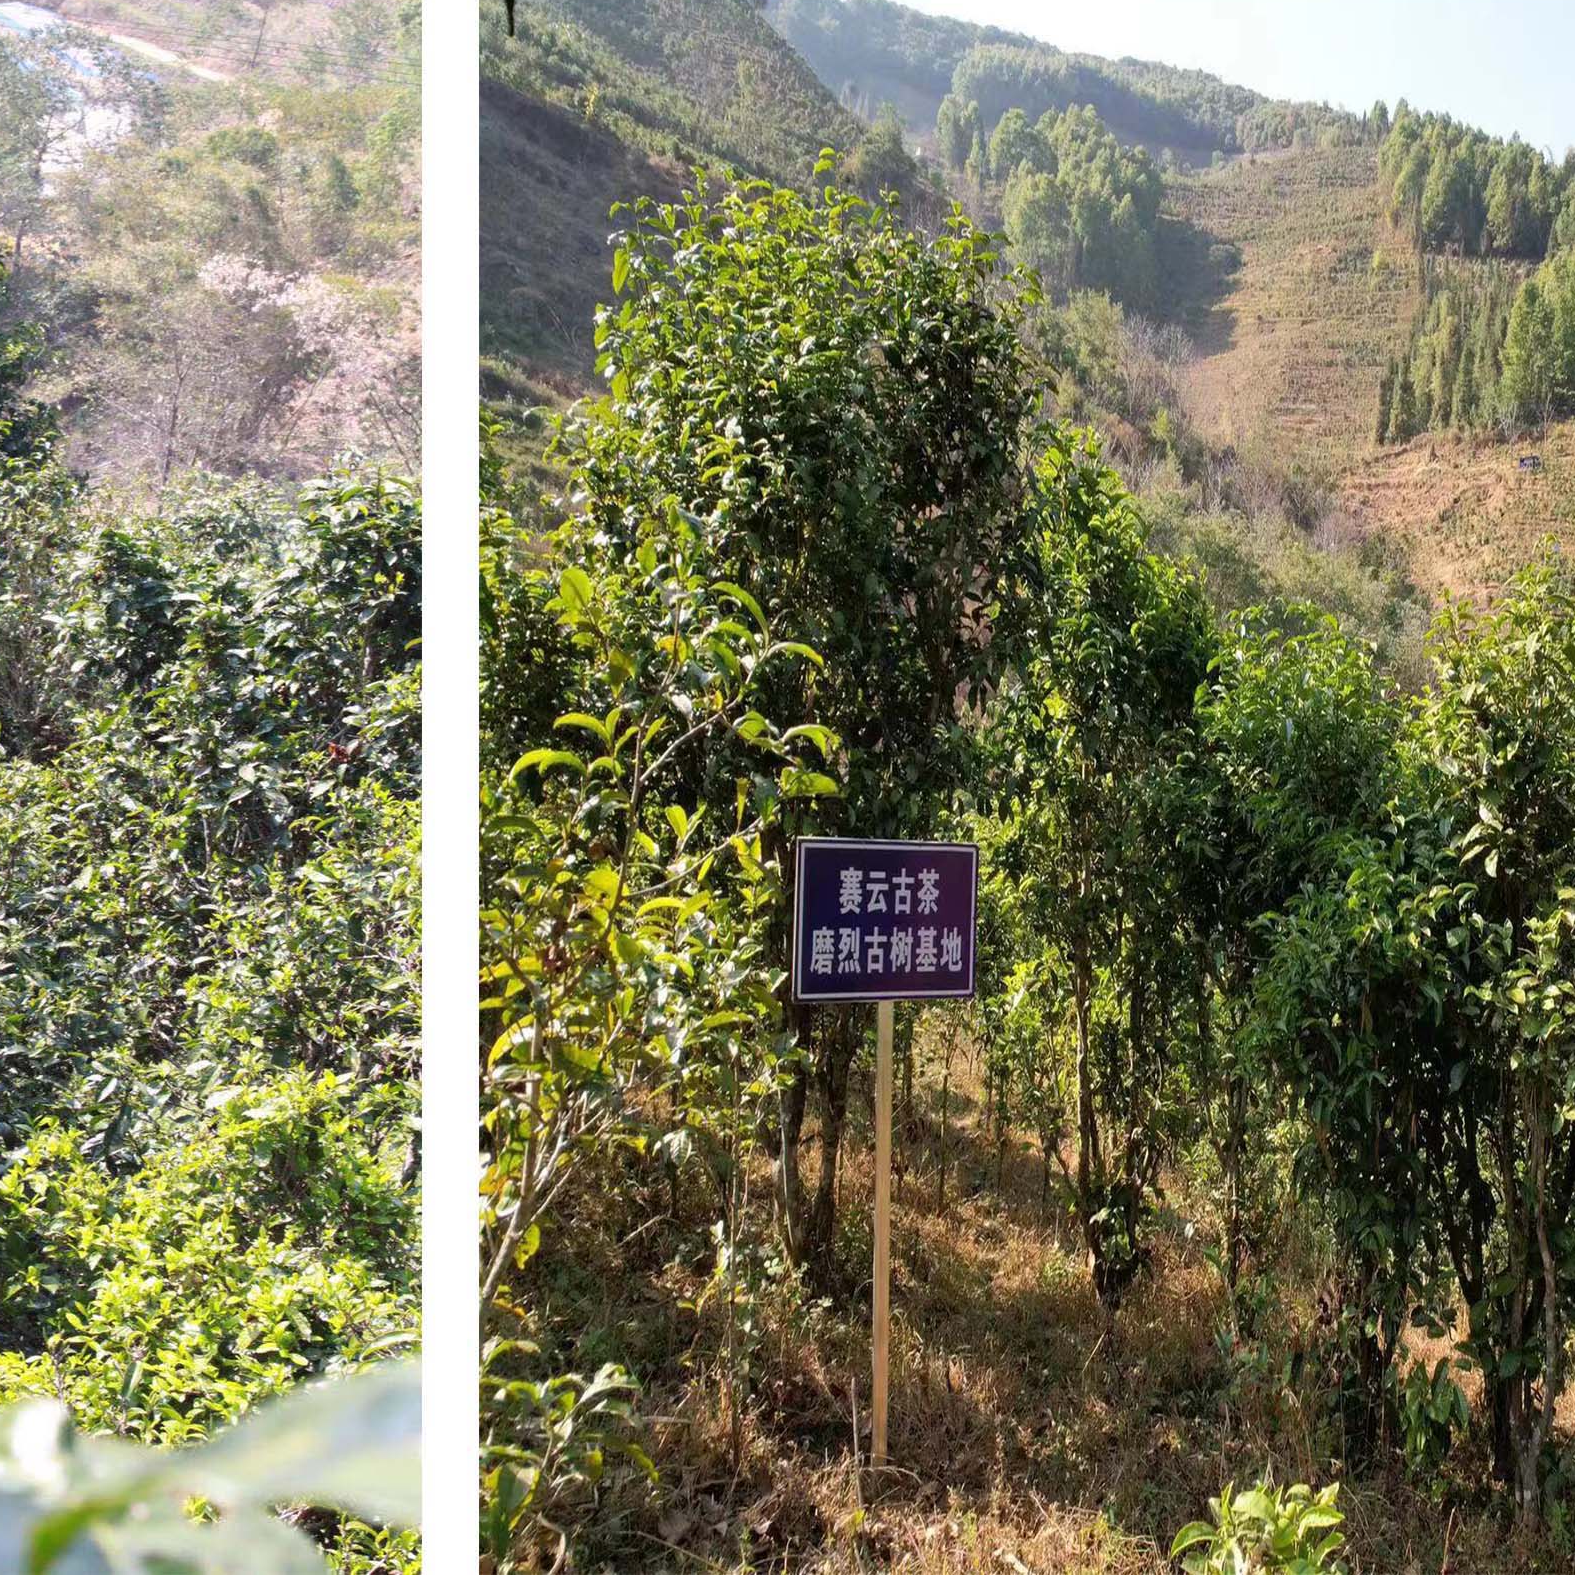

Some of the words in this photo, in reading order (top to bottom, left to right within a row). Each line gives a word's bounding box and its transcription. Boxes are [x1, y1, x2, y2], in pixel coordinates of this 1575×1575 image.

[838, 867, 940, 915] 赛云古茶
[810, 926, 963, 975] 磨烈古树基地
